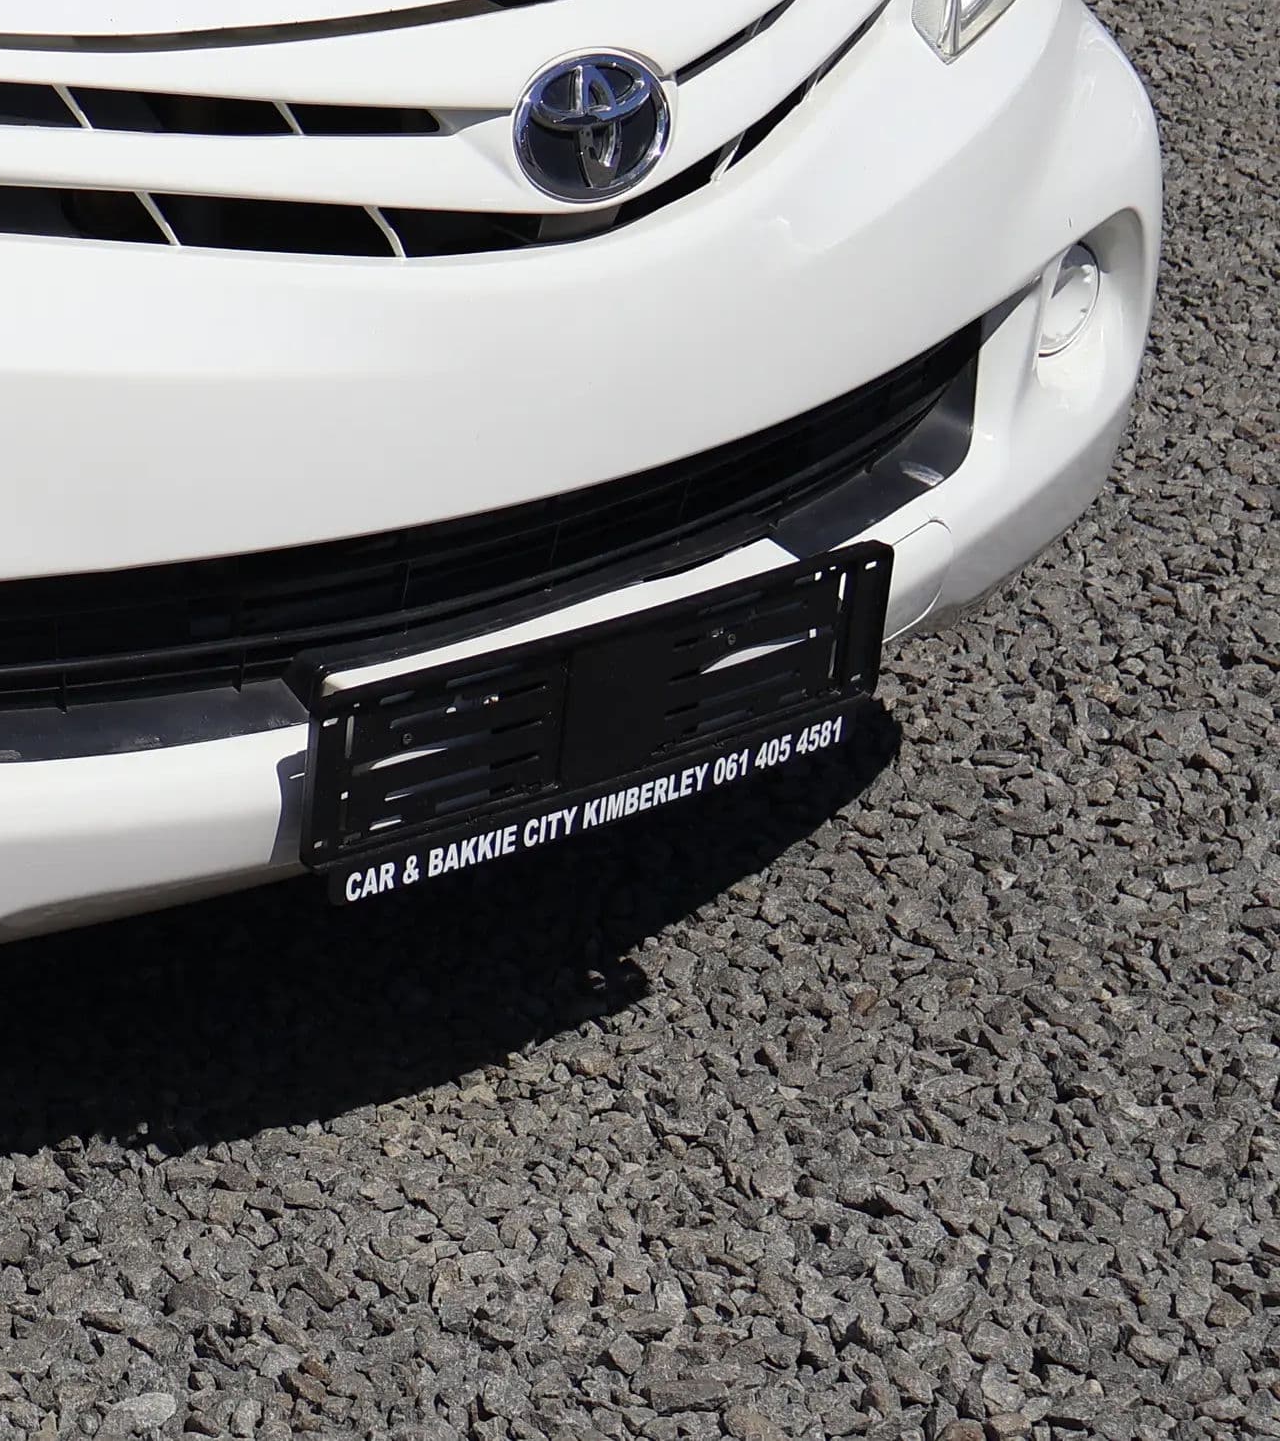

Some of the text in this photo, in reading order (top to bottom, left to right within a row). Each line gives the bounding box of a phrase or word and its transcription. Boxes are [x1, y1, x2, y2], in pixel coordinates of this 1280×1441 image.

[345, 716, 843, 902] CAR & BAKKIE CITY KIMBERLEY 061 405 4581
